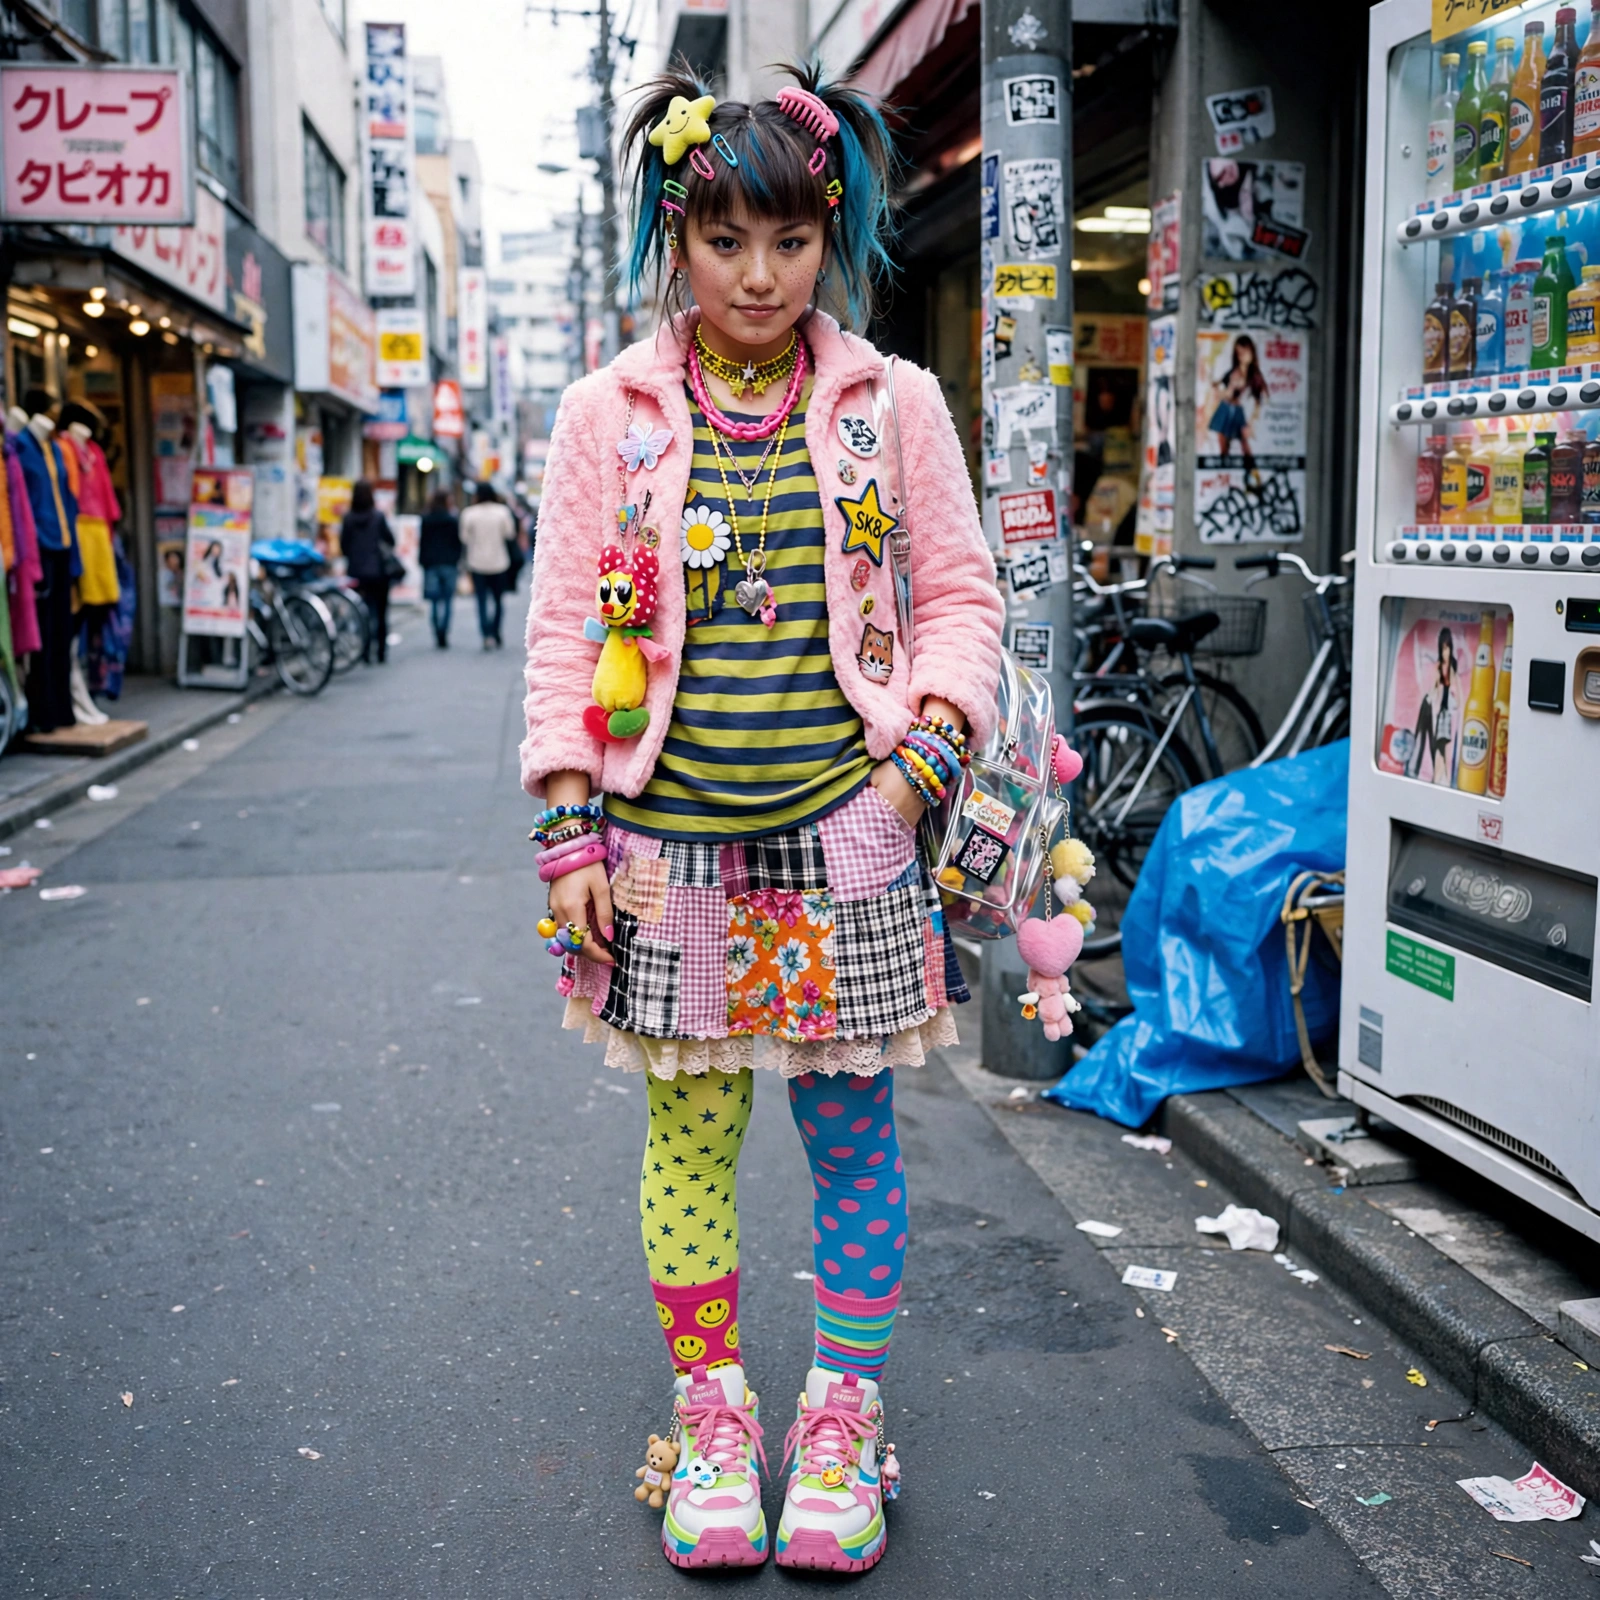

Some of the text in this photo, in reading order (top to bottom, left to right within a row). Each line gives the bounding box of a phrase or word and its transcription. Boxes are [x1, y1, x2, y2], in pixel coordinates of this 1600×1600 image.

[13, 84, 172, 134] クレープ
[17, 159, 170, 206] タピオカ
[855, 510, 882, 539] SK8
